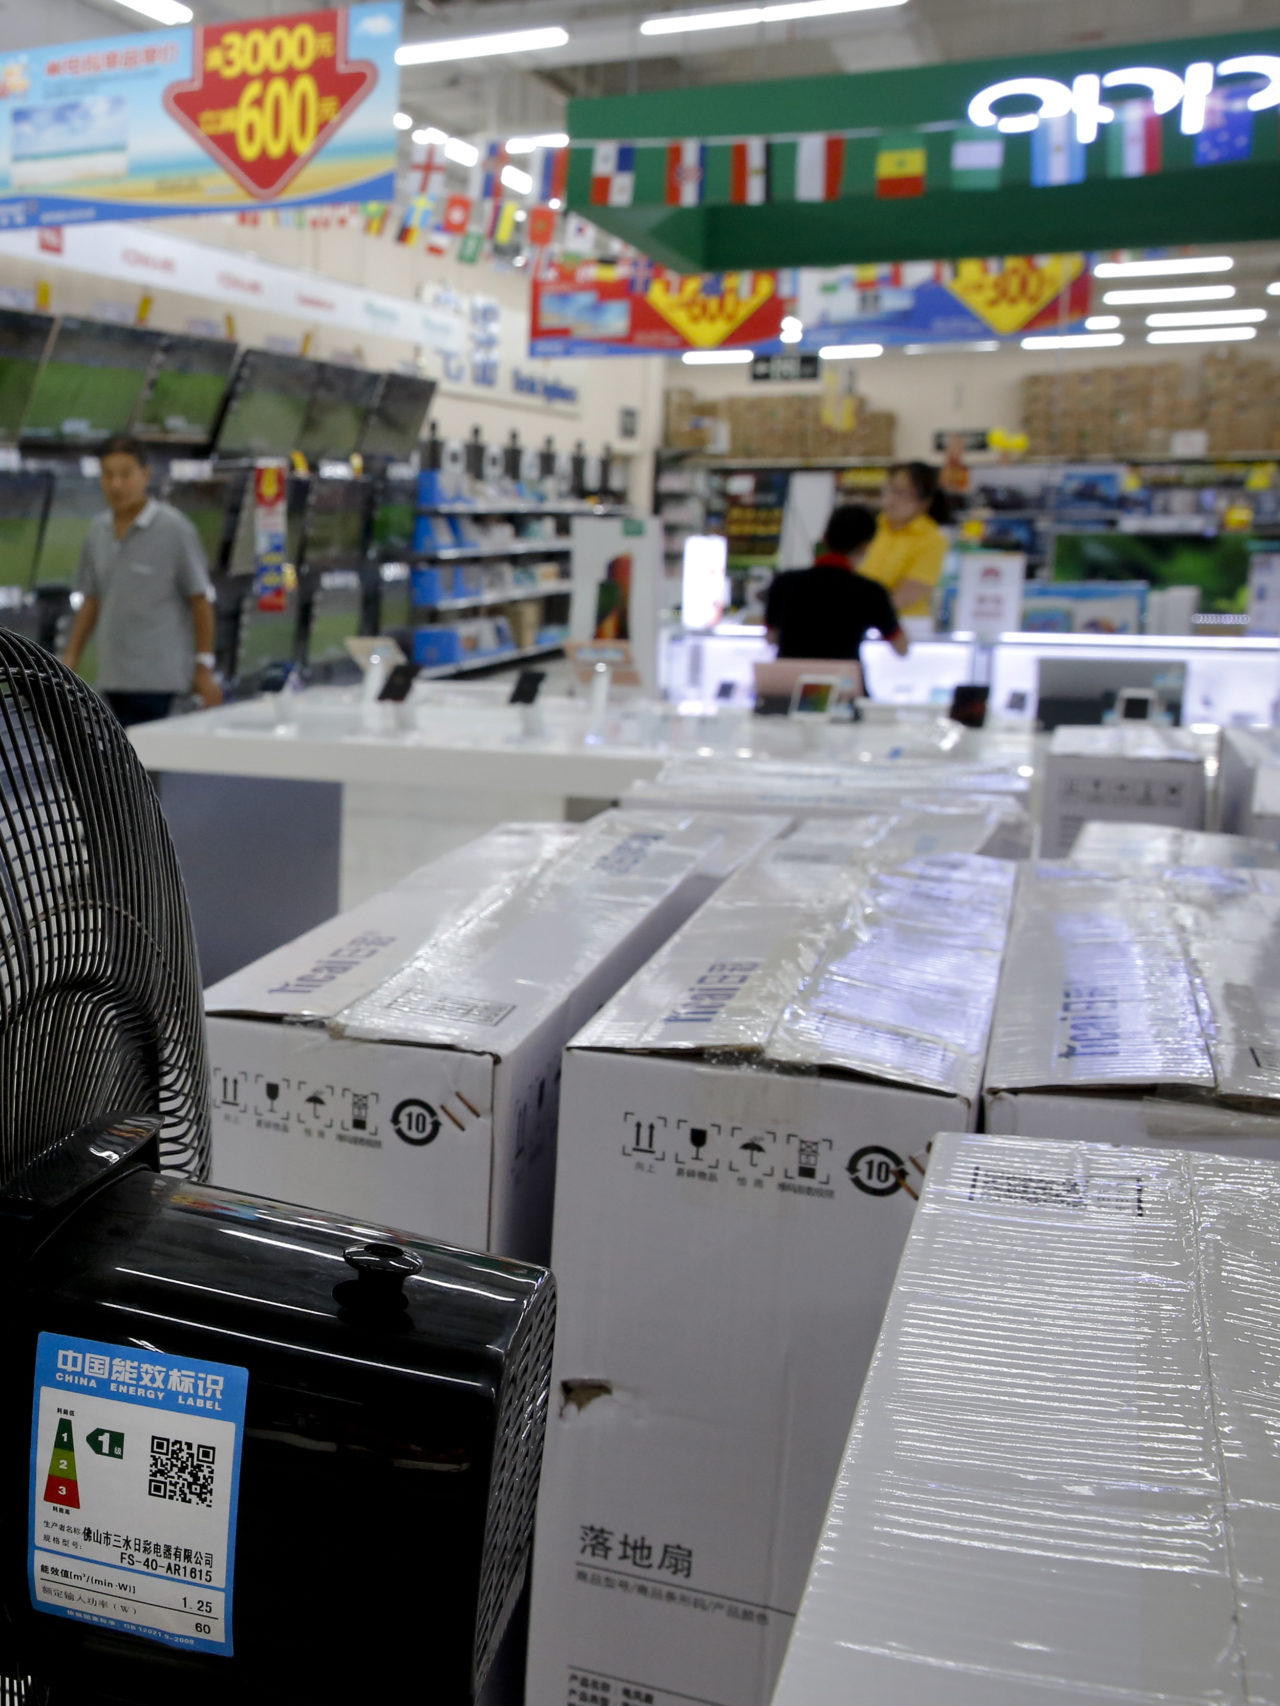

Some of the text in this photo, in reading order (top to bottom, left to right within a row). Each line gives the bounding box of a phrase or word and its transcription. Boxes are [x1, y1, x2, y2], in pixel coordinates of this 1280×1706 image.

[405, 1111, 427, 1134] 10
[865, 1158, 891, 1184] 10
[56, 1349, 225, 1399] 中国能效标识
[55, 1372, 222, 1411] CHINA ENERGY LABEL
[61, 1432, 68, 1443] 1
[58, 1459, 68, 1470] 2
[57, 1485, 67, 1496] 3
[82, 1525, 214, 1569] 佛山市三水日彩电器有限公司
[579, 1524, 694, 1579] 落地扇
[119, 1552, 213, 1583] FS-40-AR1615
[182, 1597, 213, 1614] 1.25
[195, 1623, 212, 1635] 60
